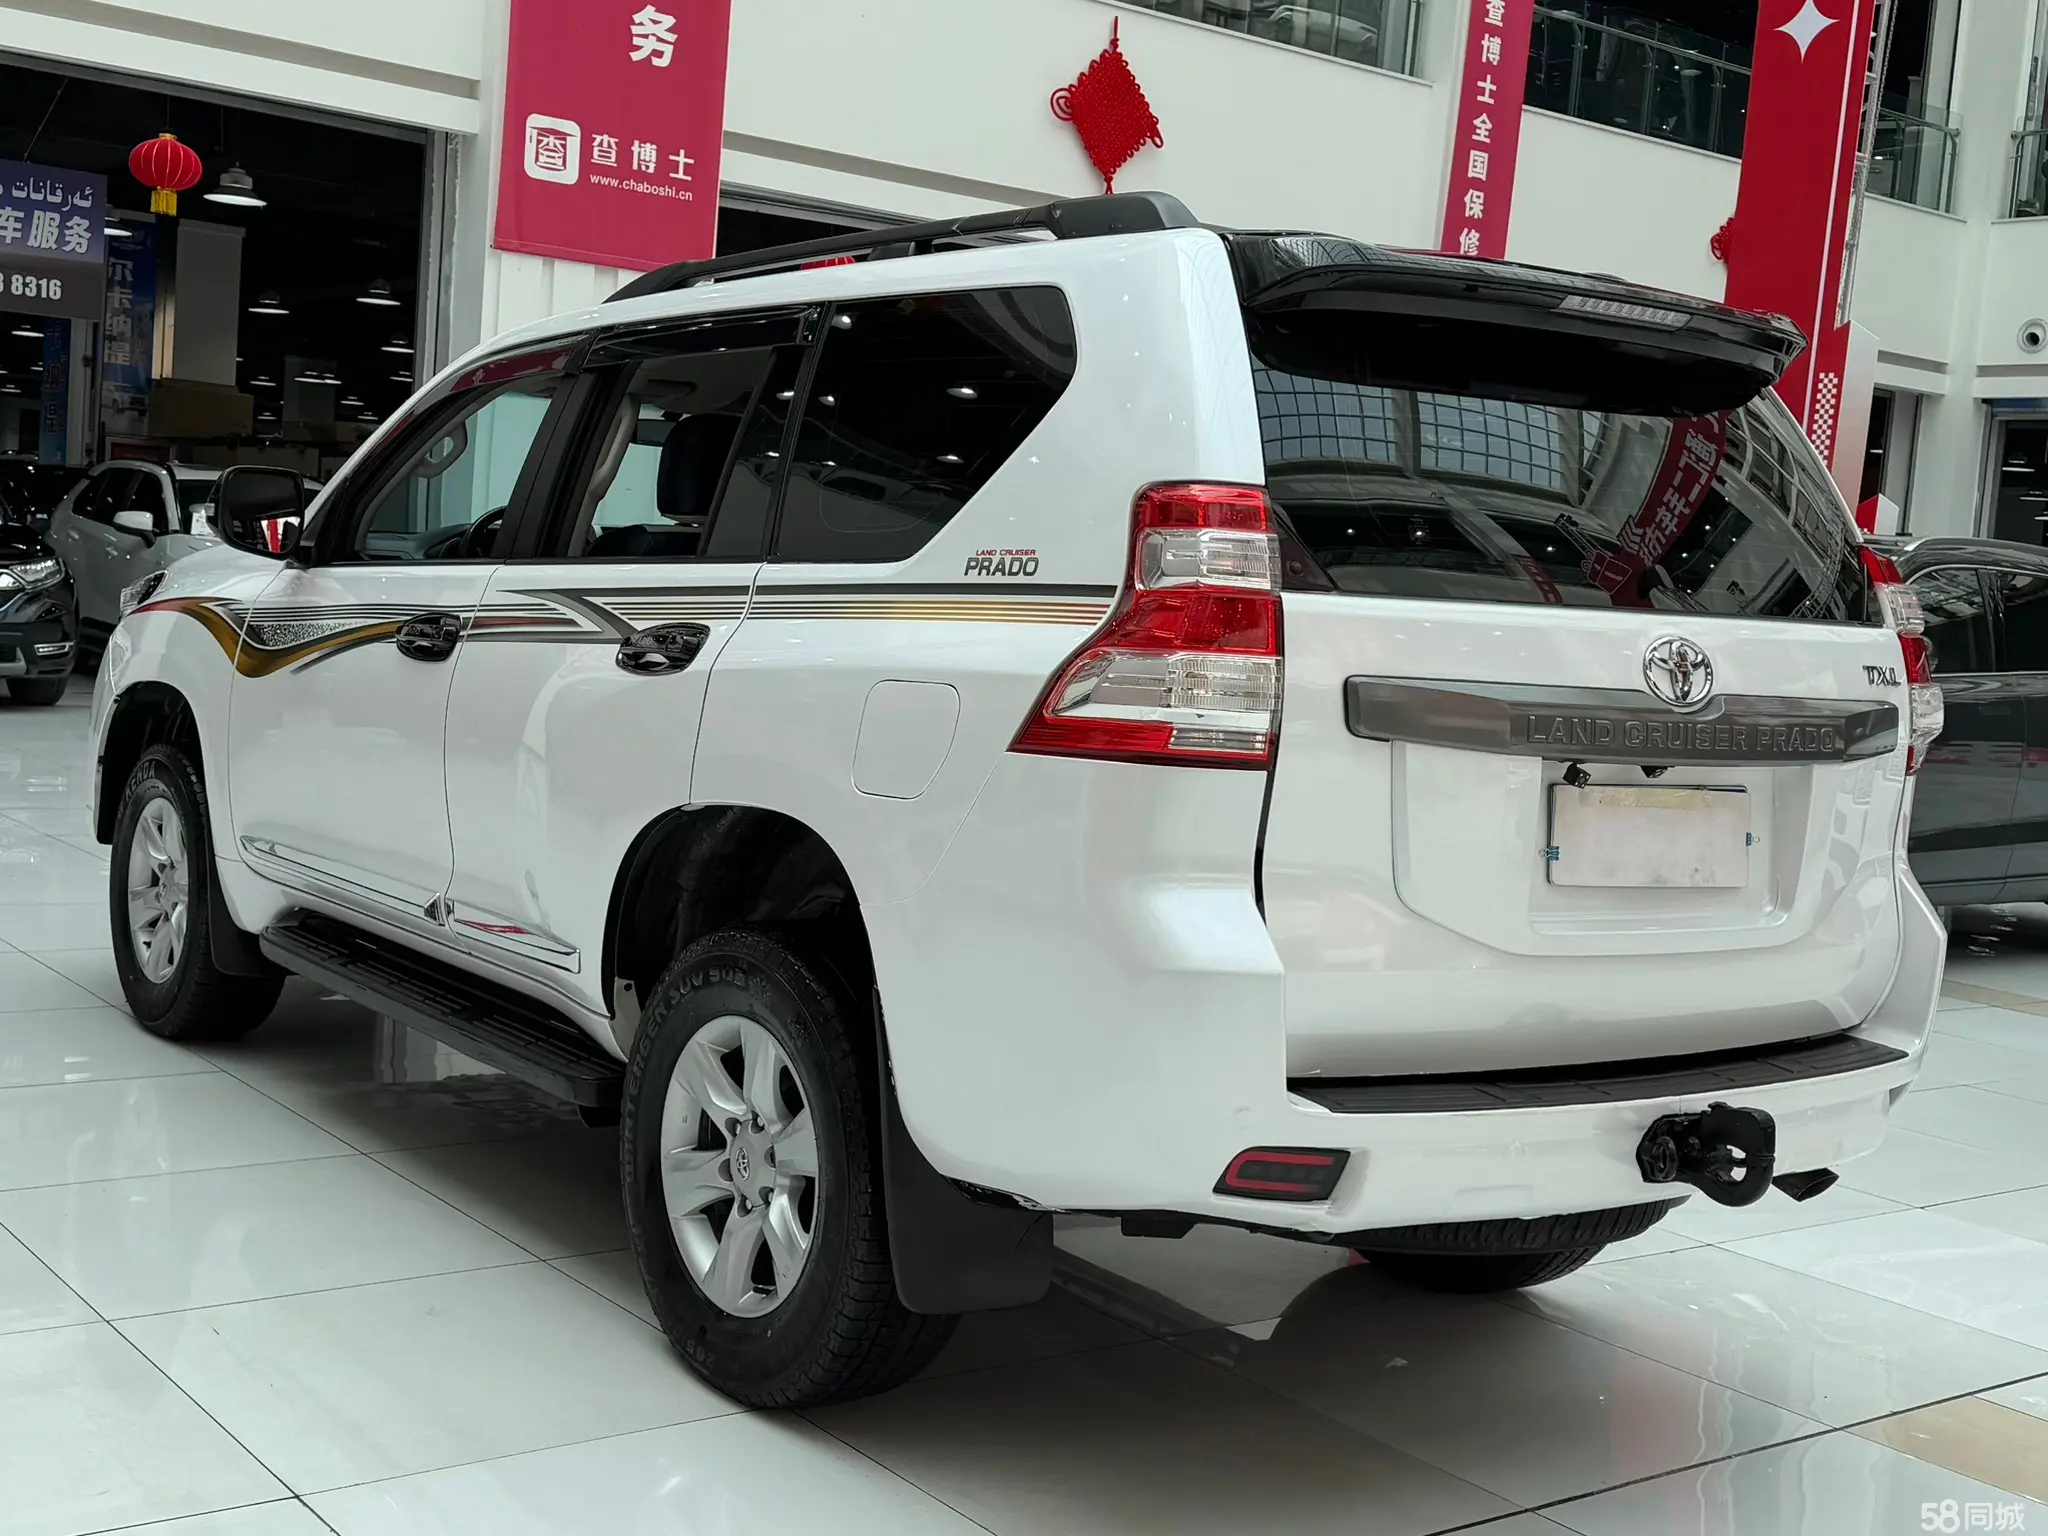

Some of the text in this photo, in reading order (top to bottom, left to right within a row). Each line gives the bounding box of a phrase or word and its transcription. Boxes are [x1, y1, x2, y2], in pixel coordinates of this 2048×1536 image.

[629, 4, 678, 68] 务
[1459, 0, 1505, 256] 查博士全国保修
[590, 133, 695, 181] 查博士
[589, 173, 693, 201] www.chaboshi.cn
[0, 206, 92, 254] 车服务
[11, 274, 62, 300] 8316
[964, 557, 1039, 576] PRADO
[975, 549, 1036, 557] LAND CRUISER
[1526, 715, 1838, 752] LAND CRUISER PRADO
[669, 973, 704, 1005] SUV
